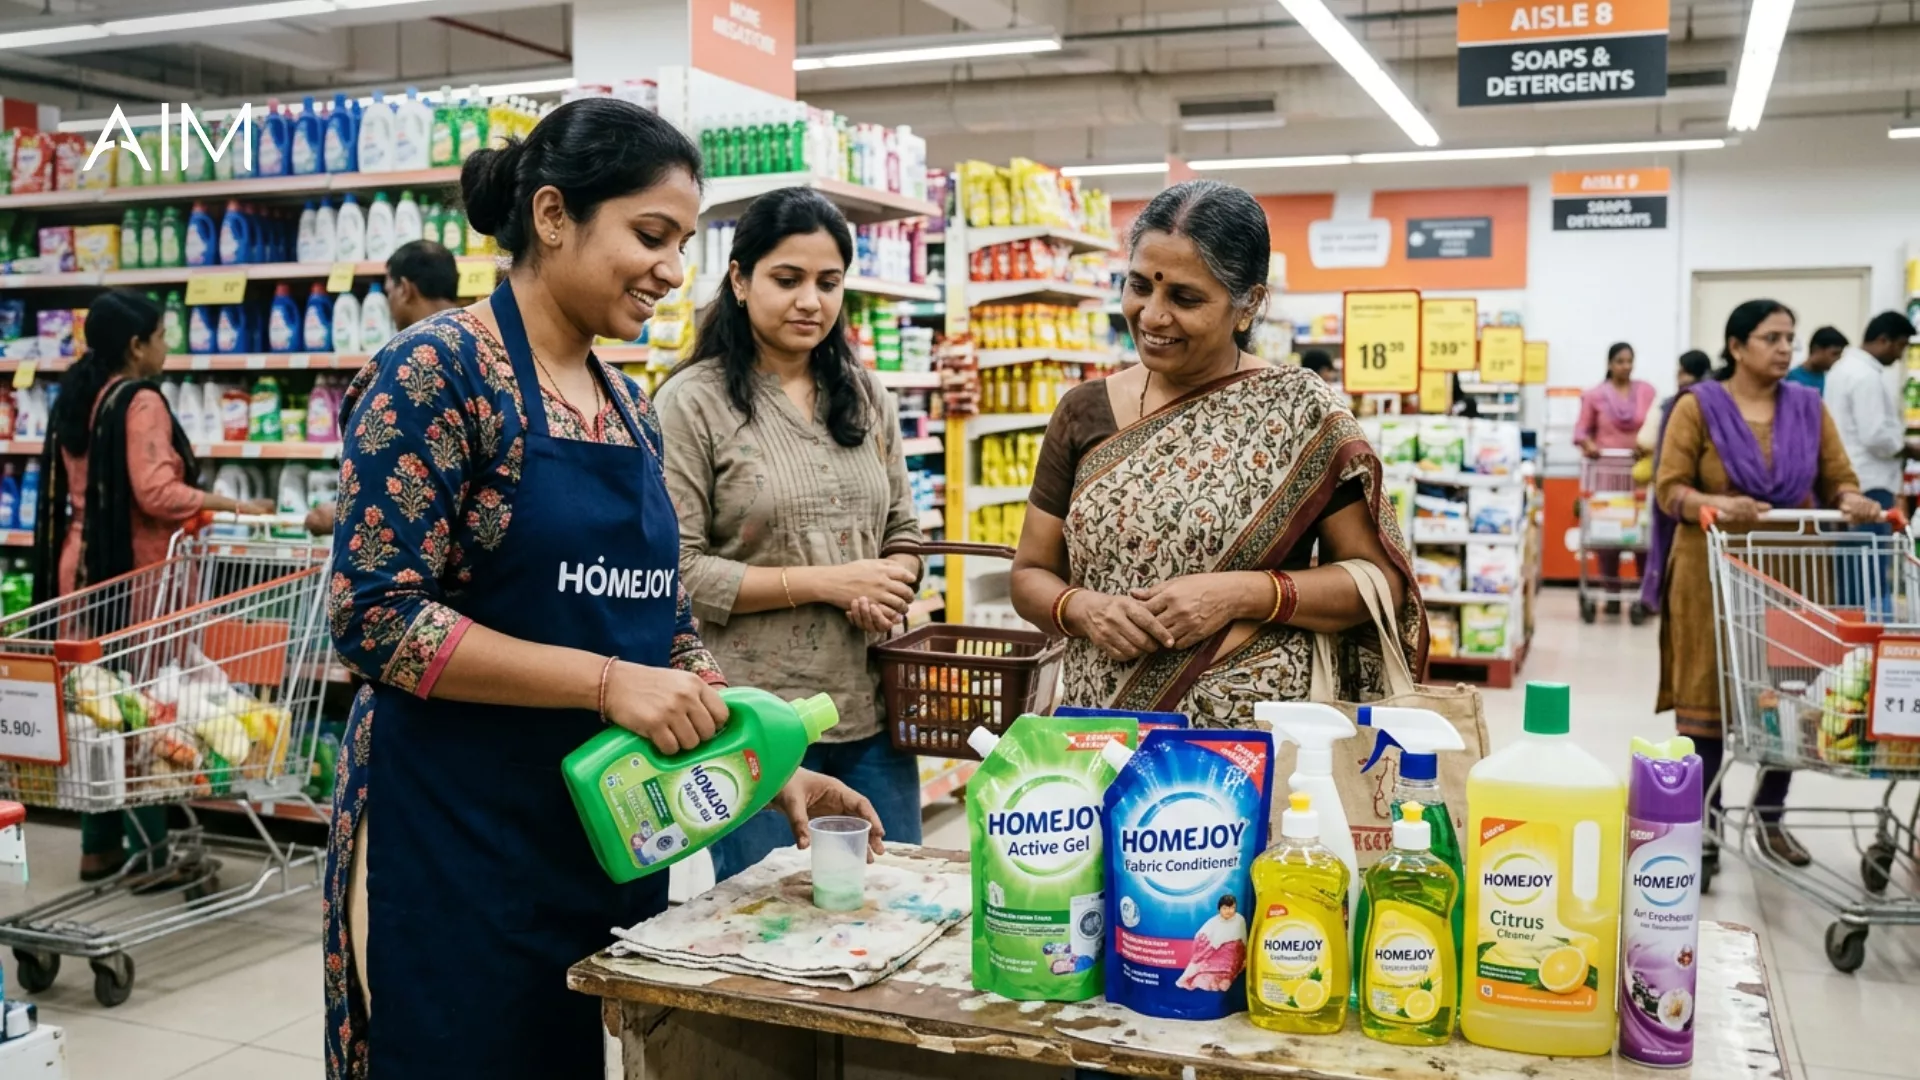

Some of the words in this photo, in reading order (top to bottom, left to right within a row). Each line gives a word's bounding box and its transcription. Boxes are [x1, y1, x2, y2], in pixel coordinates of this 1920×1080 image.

[1510, 3, 1589, 31] AISLE
[1595, 3, 1613, 26] 8
[1511, 48, 1587, 71] SOAPS
[1592, 46, 1611, 67] &
[1486, 69, 1635, 97] DETERGENTS
[1359, 342, 1387, 370] 18
[1007, 840, 1059, 857] Active
[1063, 835, 1090, 853] Gel
[1122, 822, 1245, 853] HOMEJOY
[1125, 858, 1162, 873] Fabric
[1483, 873, 1553, 888] HOMEJOY
[1489, 909, 1545, 930] Citrus
[1263, 939, 1323, 952] HOMEJOY
[1375, 949, 1435, 961] HOMEJOY
